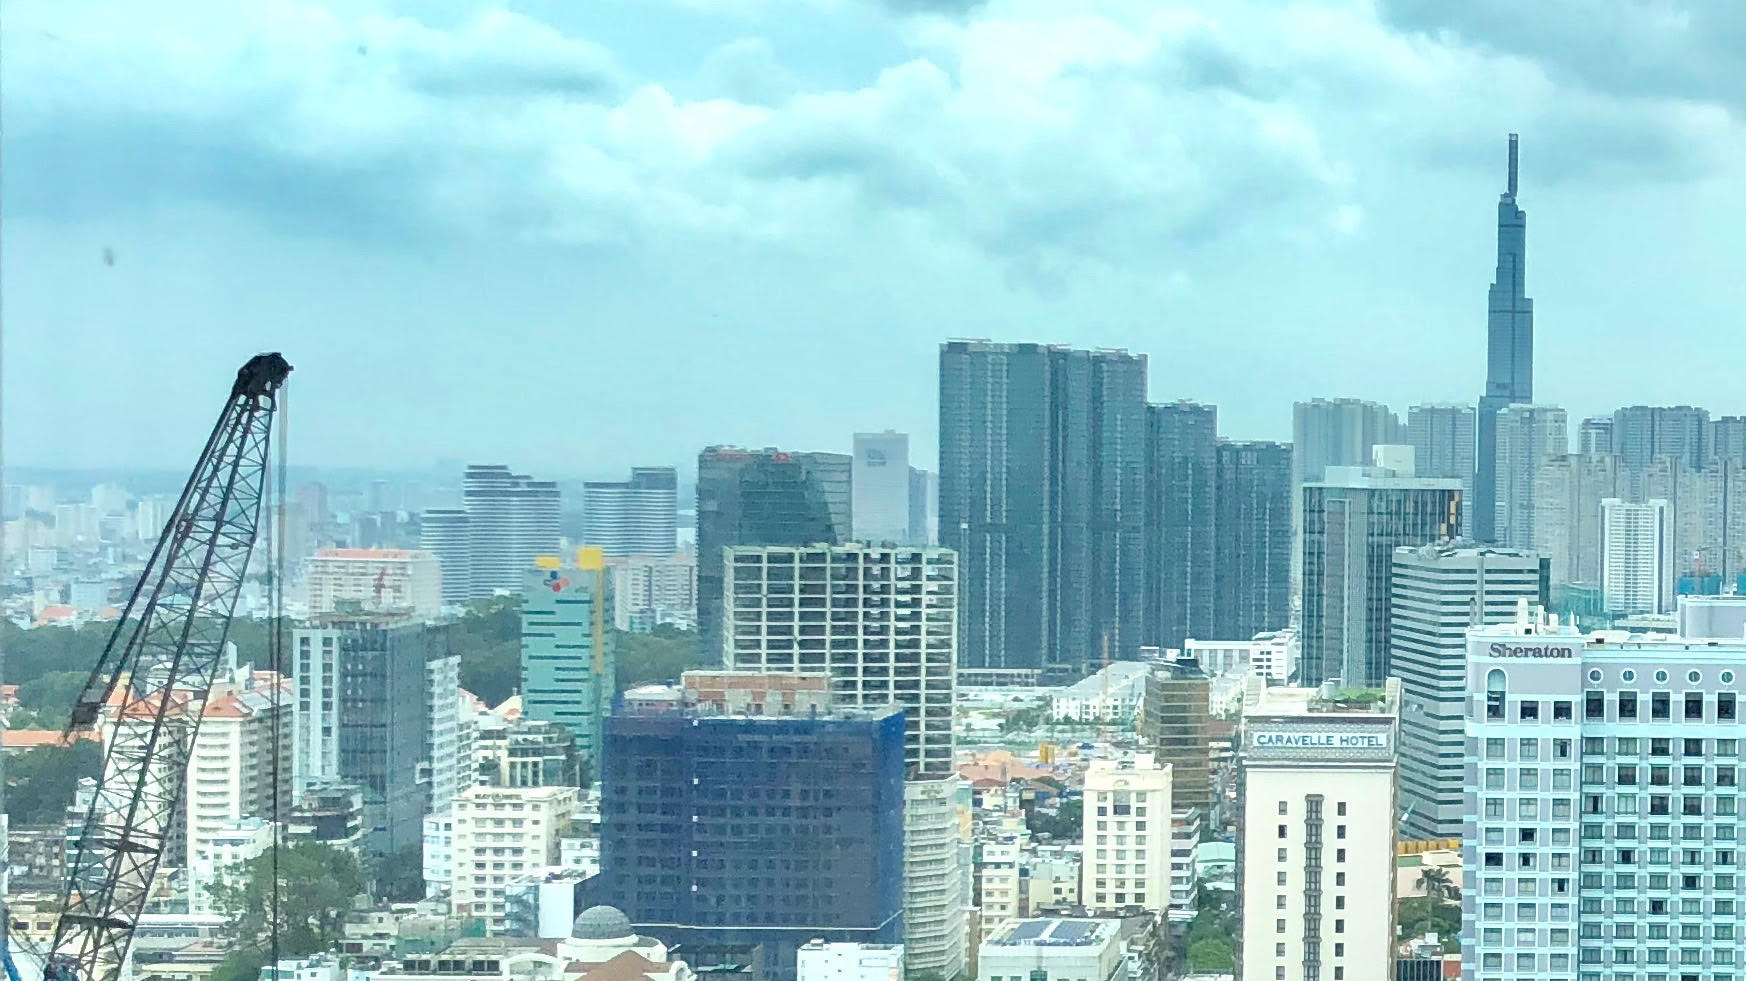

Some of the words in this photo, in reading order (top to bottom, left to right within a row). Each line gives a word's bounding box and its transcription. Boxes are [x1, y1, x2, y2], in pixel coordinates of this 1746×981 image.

[1489, 642, 1572, 658] Sheraton
[1256, 734, 1334, 746] CARAVELLE
[1340, 734, 1384, 746] HOTEL
